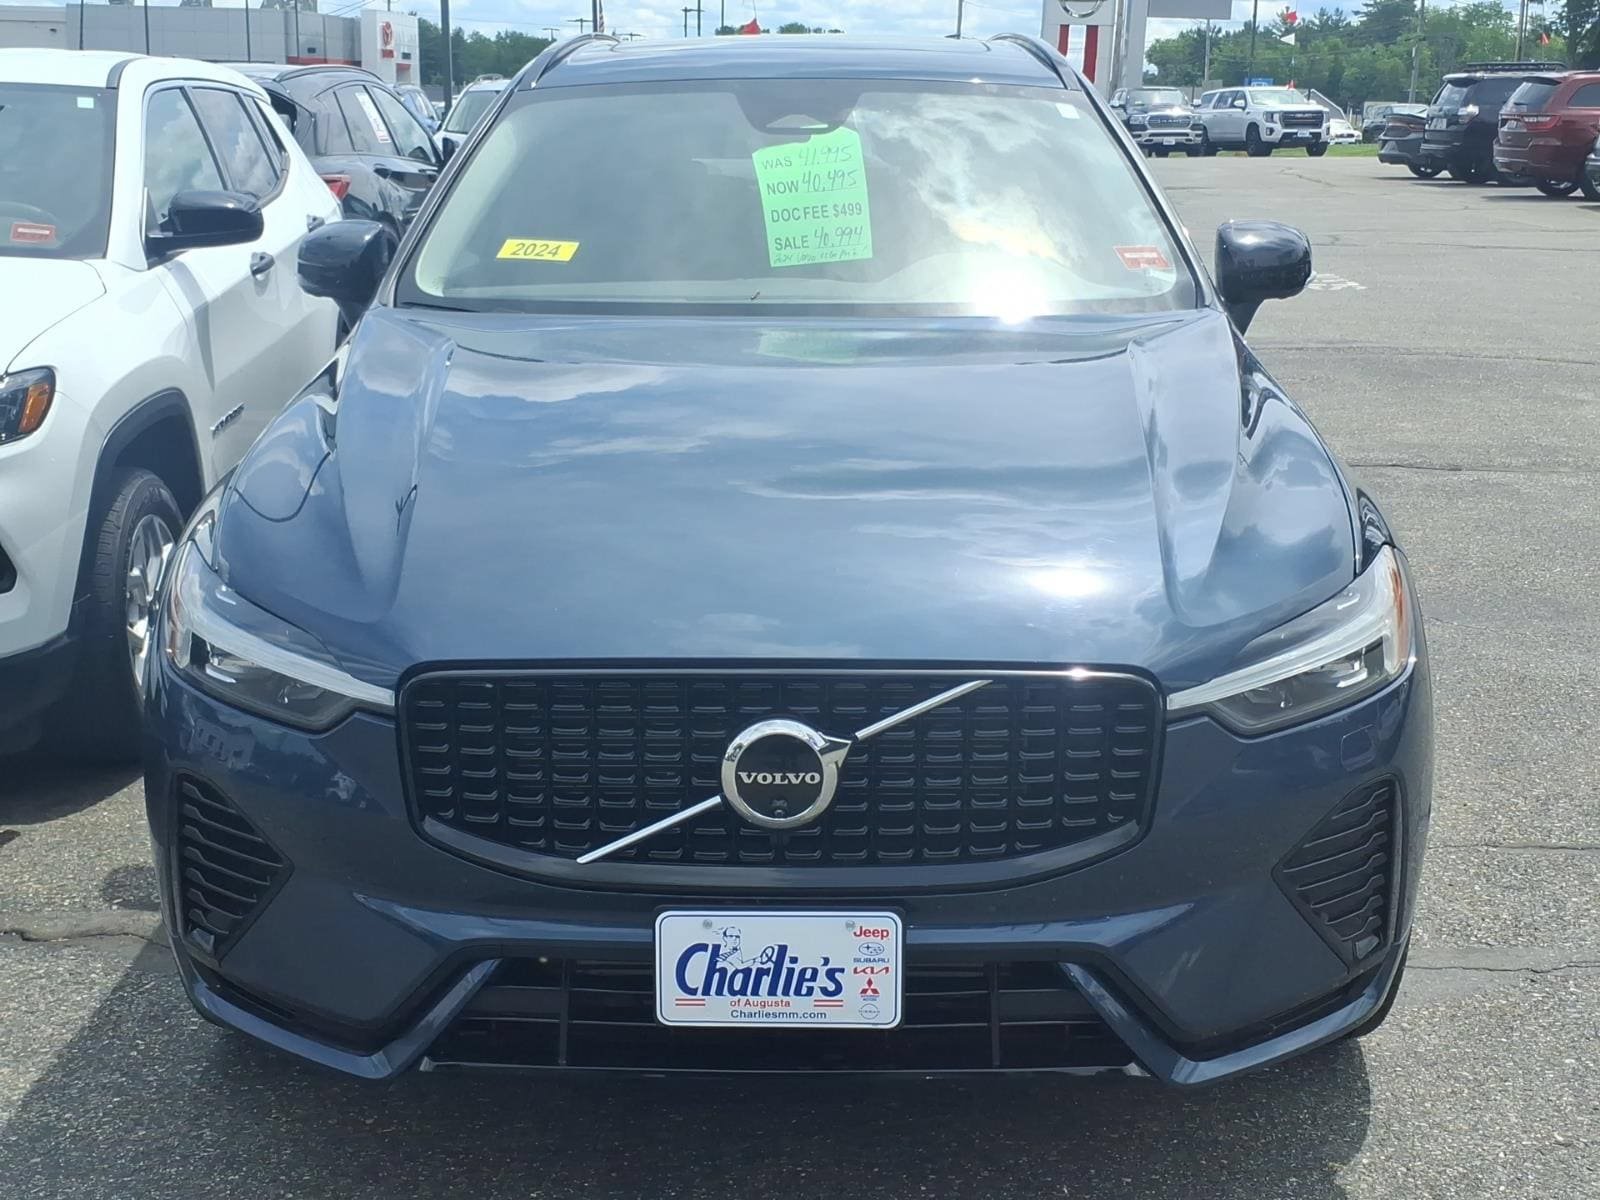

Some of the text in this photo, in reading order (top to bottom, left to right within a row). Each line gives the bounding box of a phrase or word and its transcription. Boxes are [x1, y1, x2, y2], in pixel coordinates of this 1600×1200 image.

[762, 156, 793, 169] WAS
[767, 180, 799, 195] NOW
[771, 202, 862, 222] DOC FEE $499
[510, 242, 562, 257] 2024
[774, 235, 810, 251] SALE
[738, 772, 821, 784] VOLVO
[853, 925, 890, 940] Jeep
[675, 943, 845, 998] Charlie's
[730, 998, 791, 1009] of Augusta
[730, 1009, 827, 1019] Charliesmm.com
